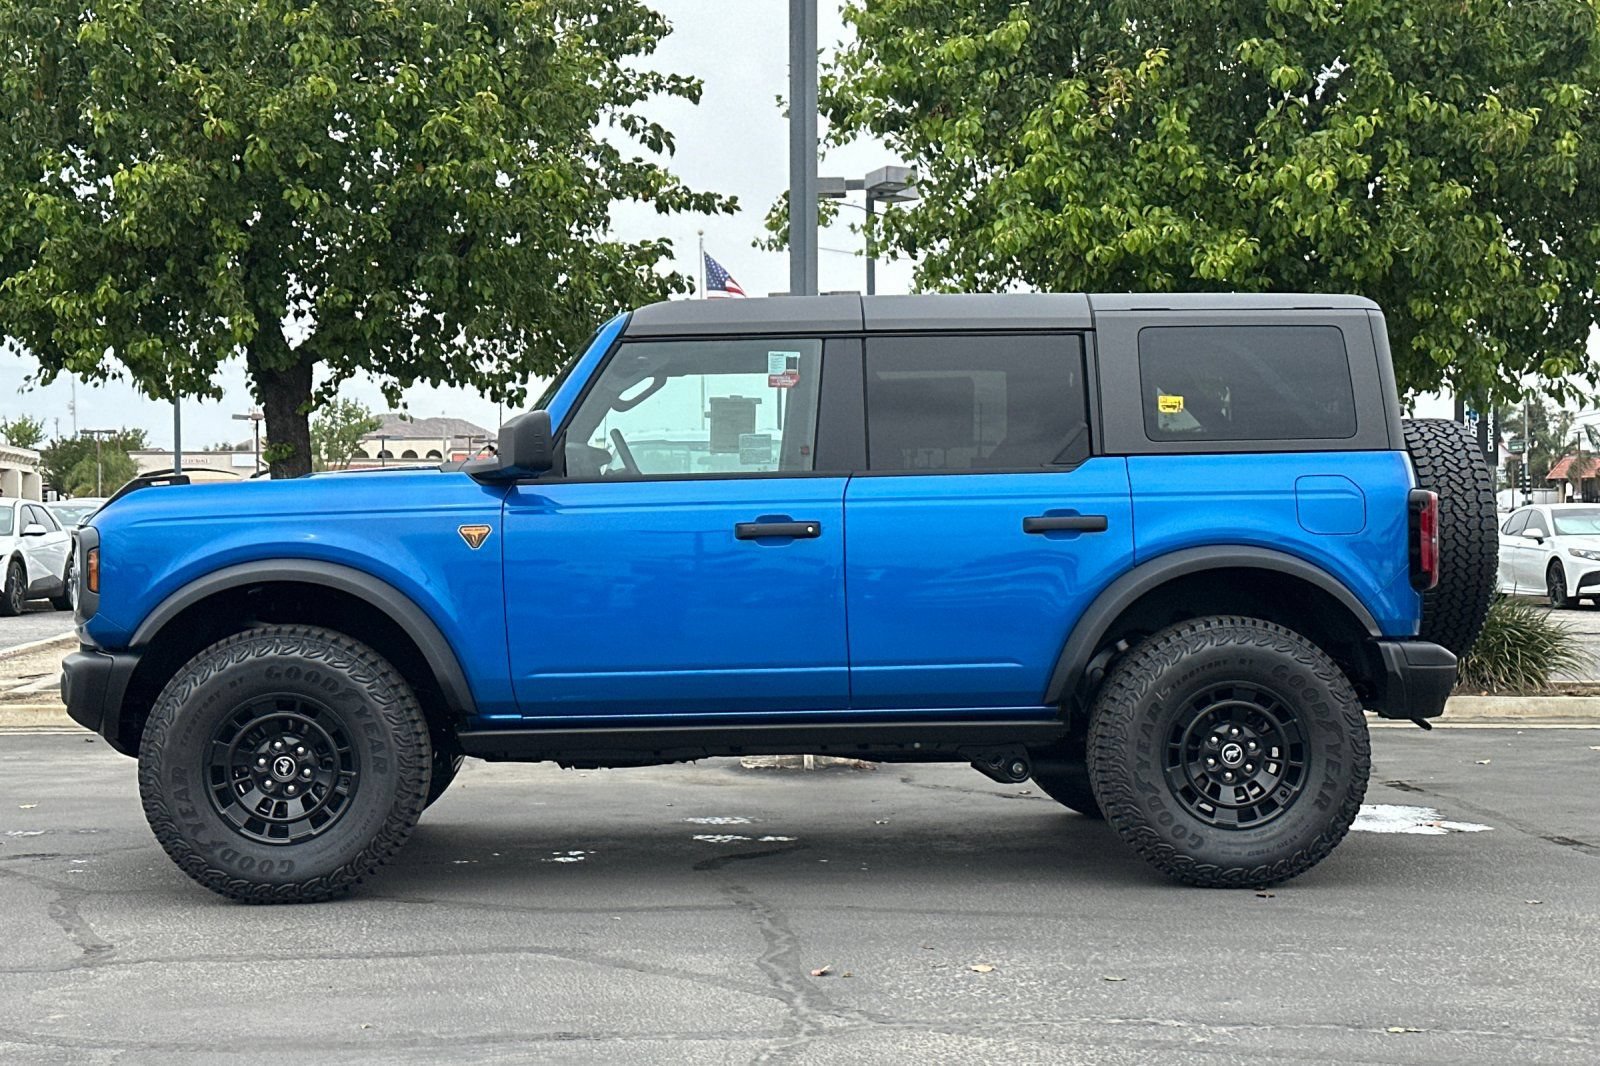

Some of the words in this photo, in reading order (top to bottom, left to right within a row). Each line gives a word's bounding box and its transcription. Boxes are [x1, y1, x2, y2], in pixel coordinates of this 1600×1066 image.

[264, 664, 390, 774] GOODYEAR
[1133, 703, 1206, 850] GOODYEAR
[1271, 664, 1345, 812] GOODYEAR
[168, 766, 296, 876] GOODYEAR
